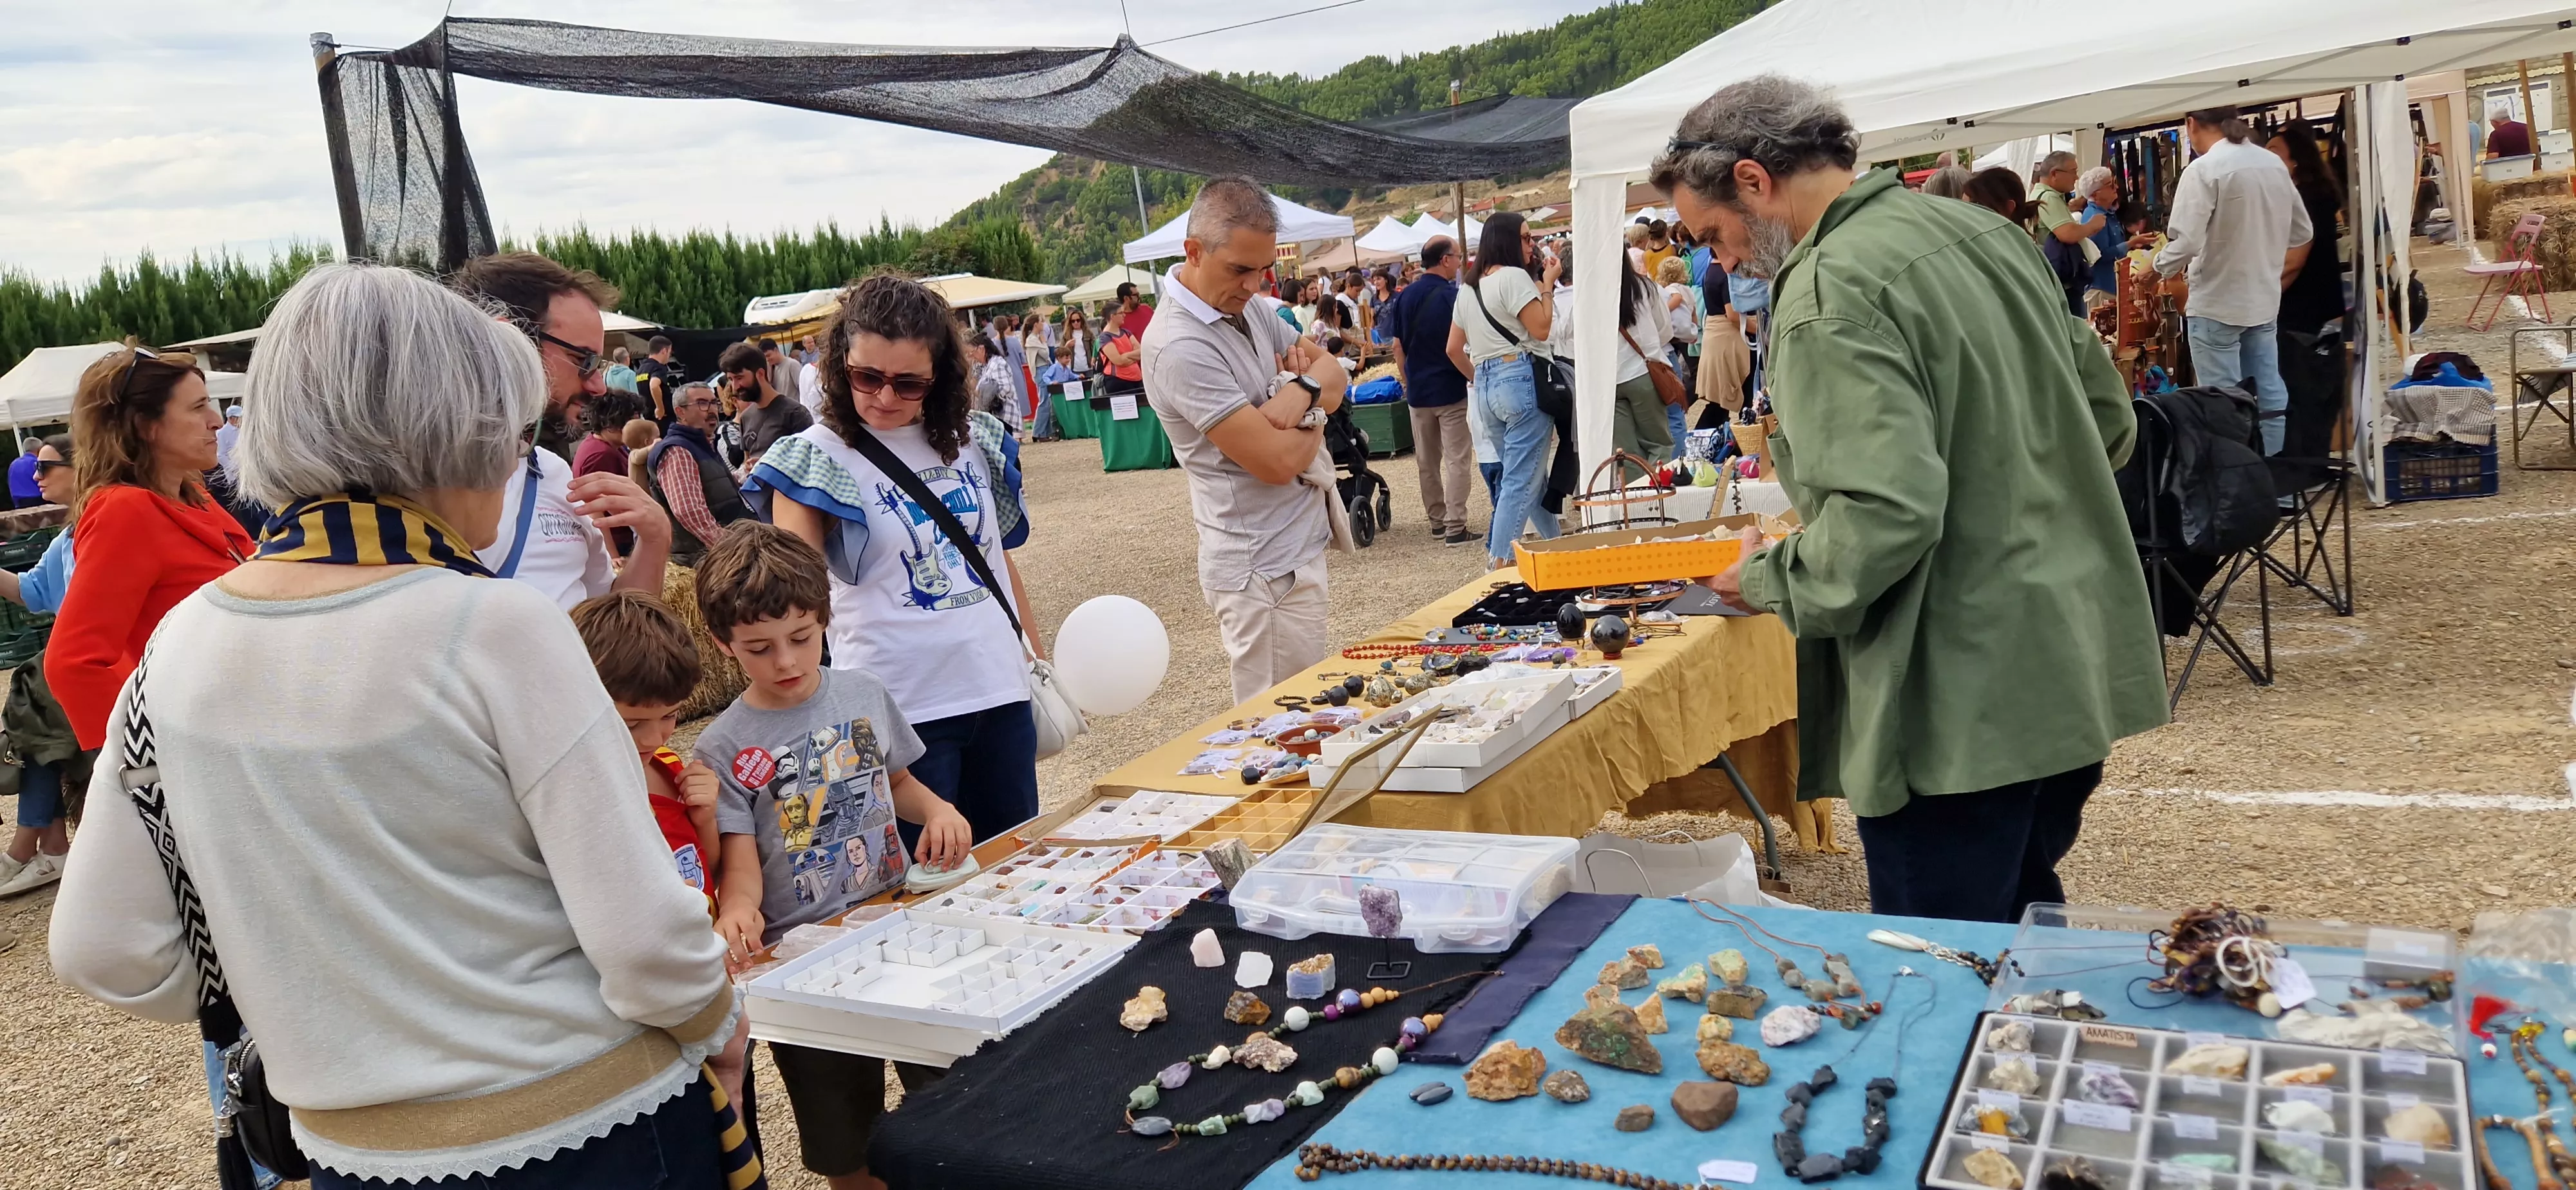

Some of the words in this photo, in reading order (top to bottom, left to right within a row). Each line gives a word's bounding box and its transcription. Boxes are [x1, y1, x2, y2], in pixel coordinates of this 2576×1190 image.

[943, 549, 960, 562] VIBES
[950, 593, 971, 606] FROM
[969, 590, 984, 601] VIGO
[736, 753, 749, 768] Río
[2086, 1026, 2136, 1041] AMATISTA
